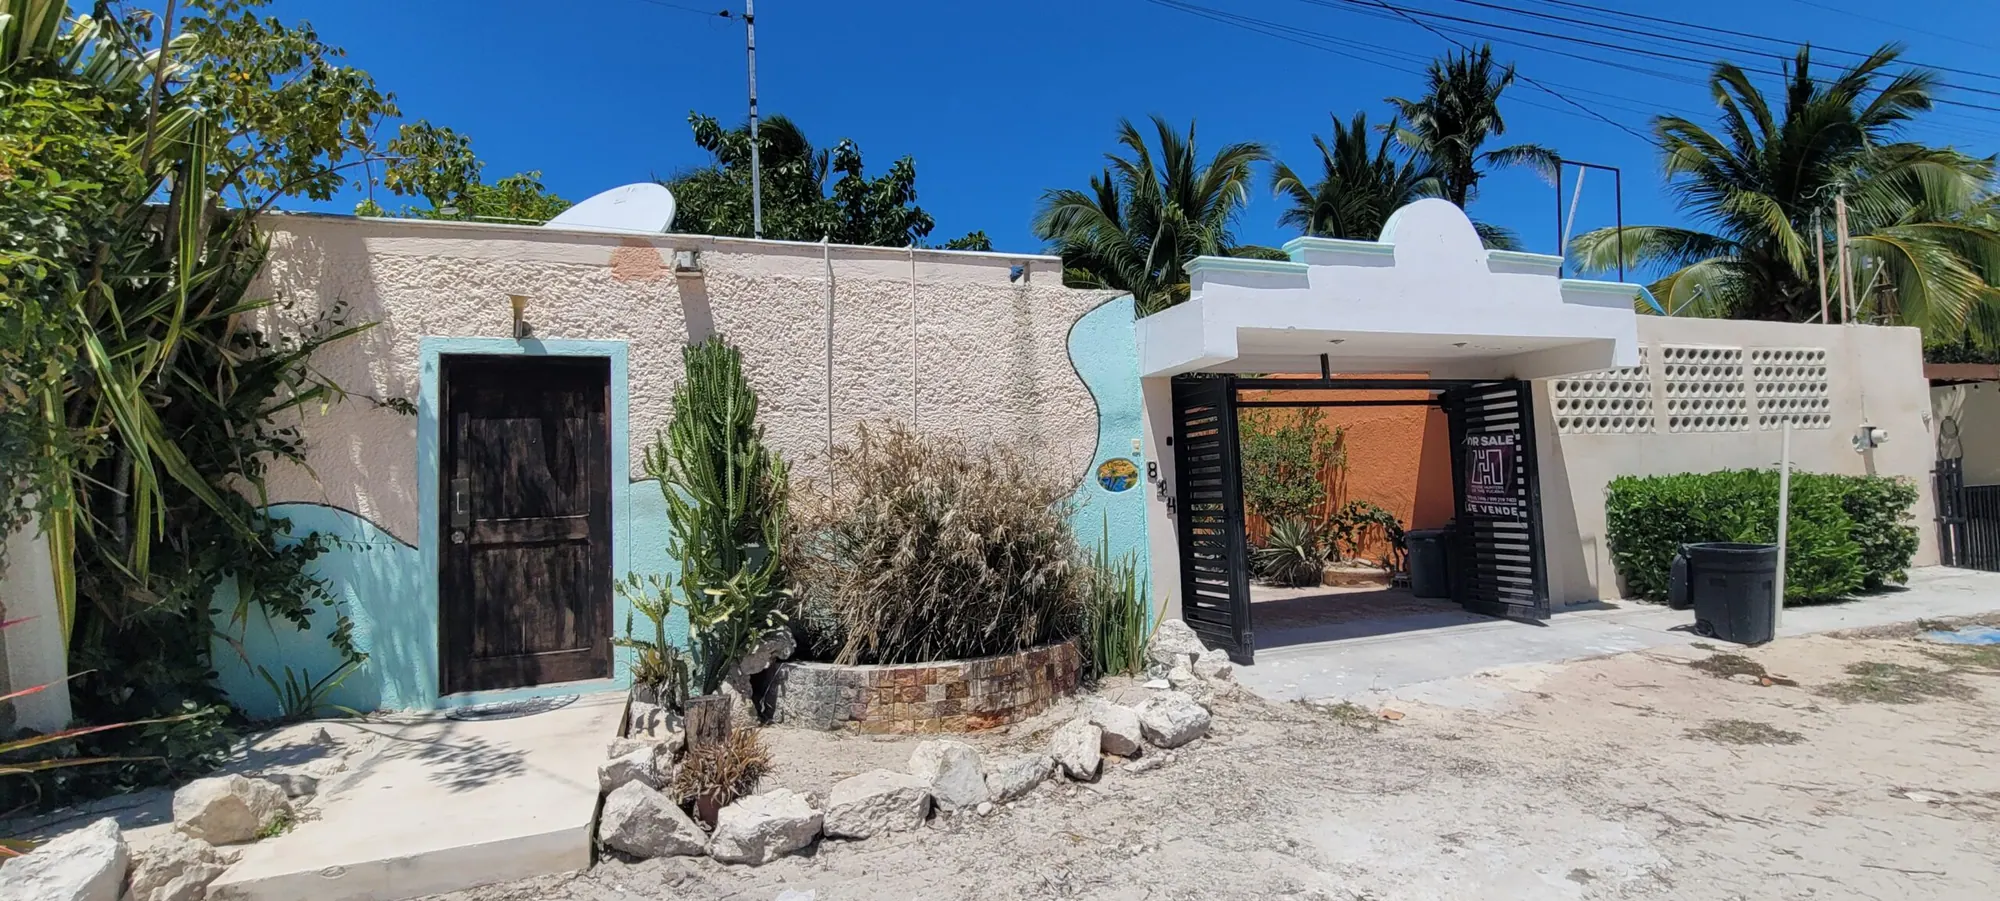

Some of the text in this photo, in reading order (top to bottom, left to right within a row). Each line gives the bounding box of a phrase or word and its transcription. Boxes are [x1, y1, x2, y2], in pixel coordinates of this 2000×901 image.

[1466, 435, 1514, 446] OR SALE
[1480, 505, 1518, 516] VENDE
